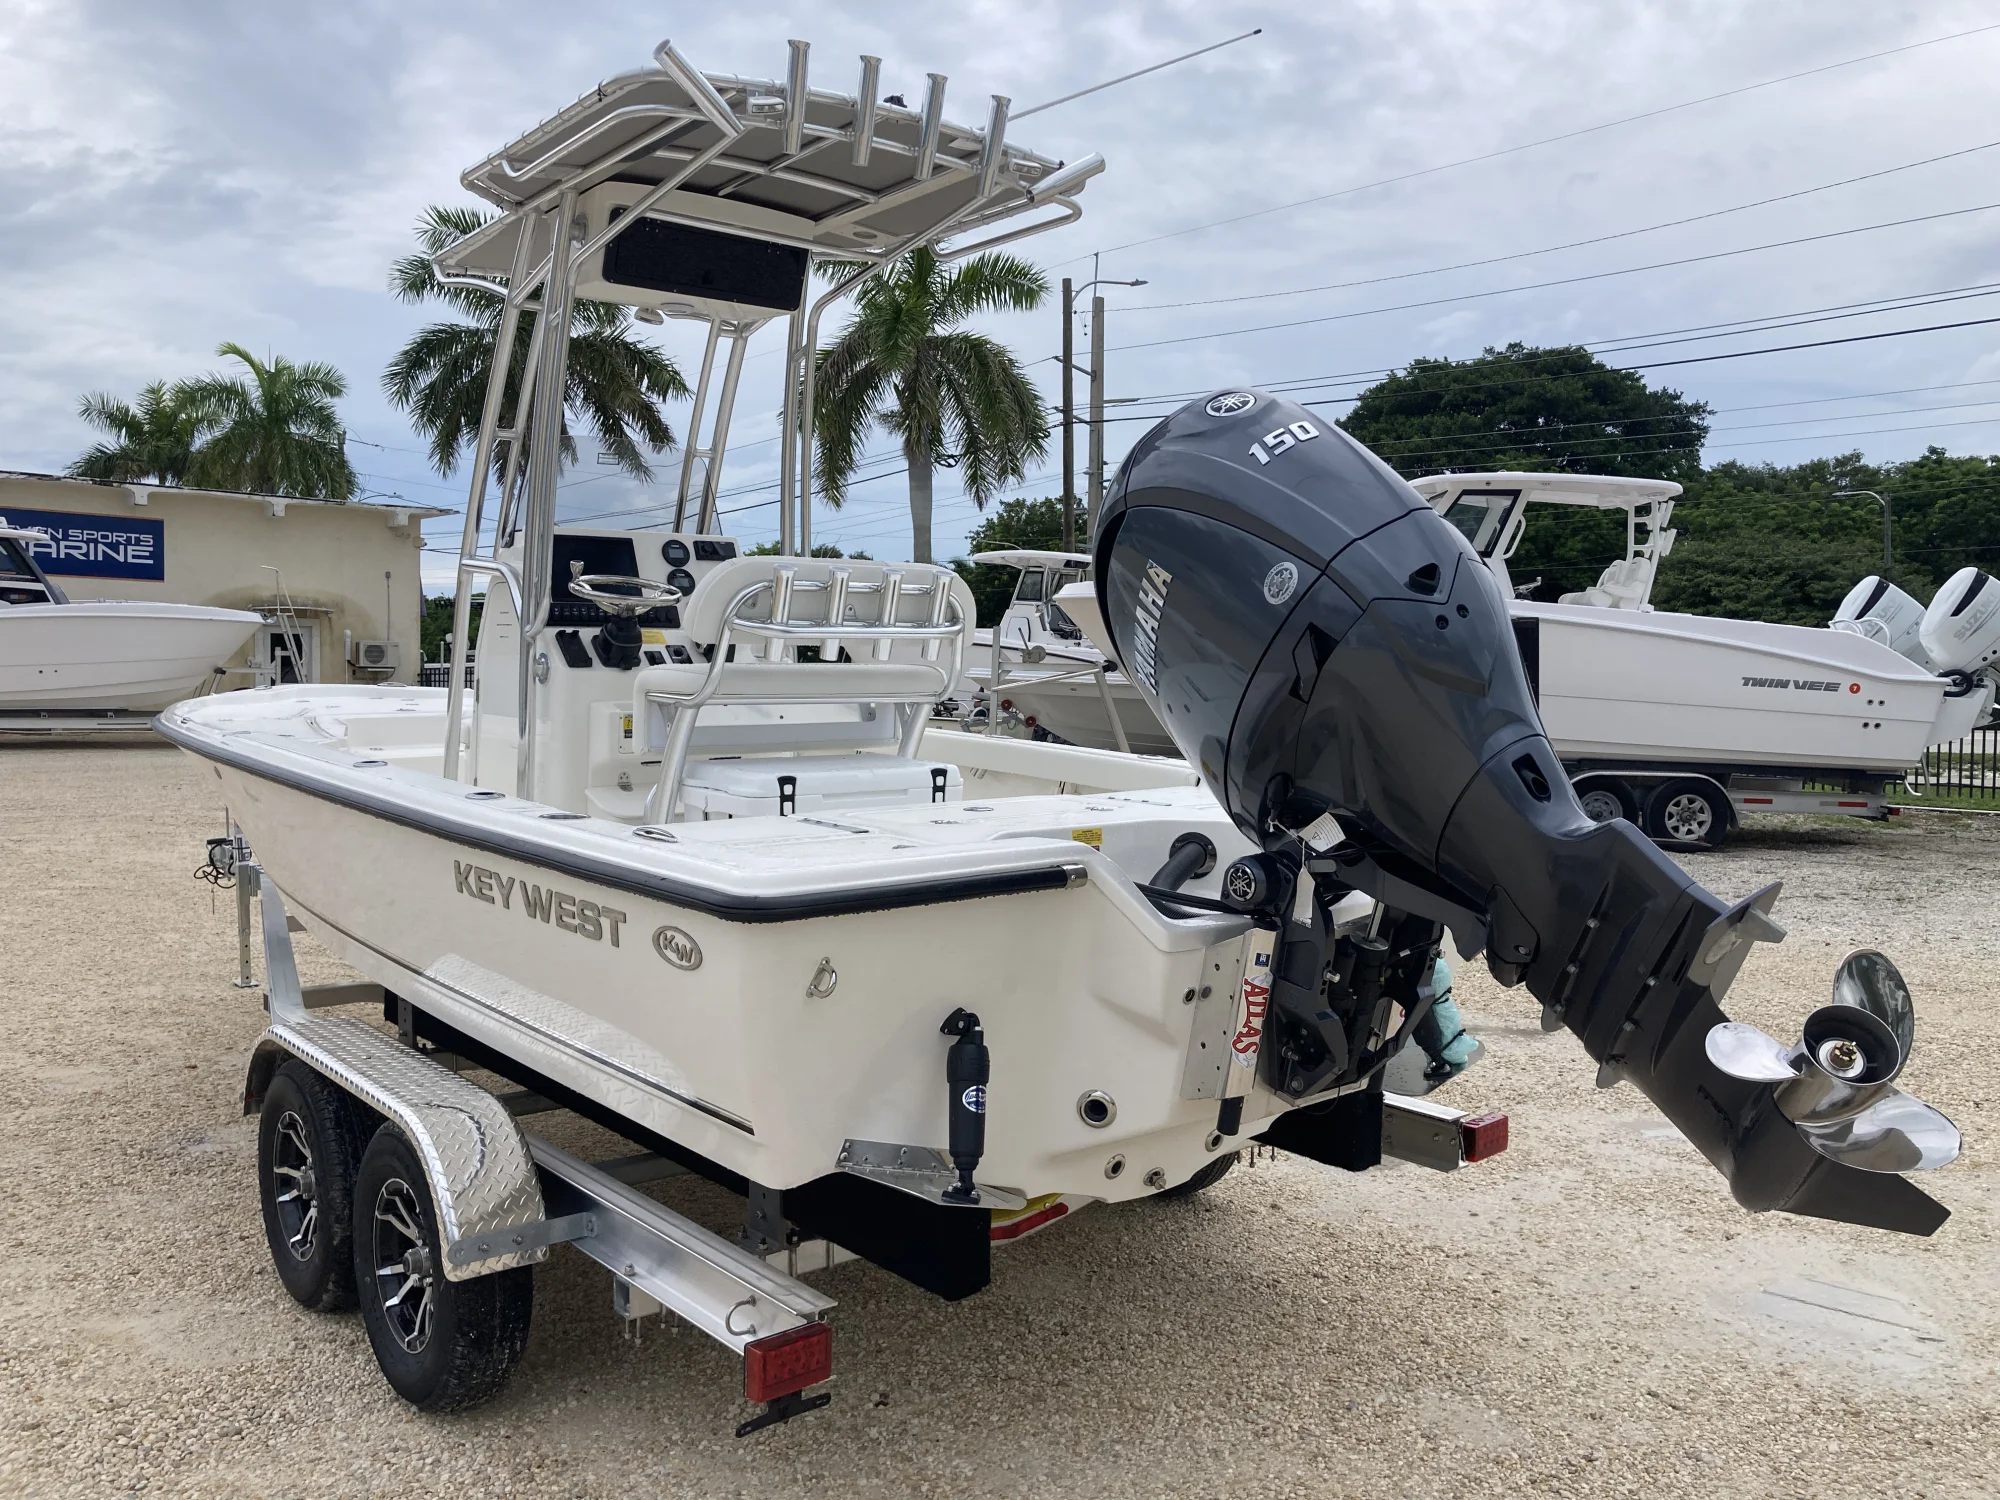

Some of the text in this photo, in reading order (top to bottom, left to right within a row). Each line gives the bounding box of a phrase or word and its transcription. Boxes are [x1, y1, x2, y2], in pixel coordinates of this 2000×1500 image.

[1248, 420, 1320, 466] 150
[68, 529, 153, 545] SPORTS
[1134, 558, 1173, 697] YAMAHA
[1953, 592, 1997, 641] SUZUKI
[1741, 676, 1791, 689] TWIN
[1792, 679, 1842, 692] VEE
[454, 860, 626, 949] KEY WEST
[661, 932, 694, 964] KW
[1231, 977, 1270, 1055] ATLAS
